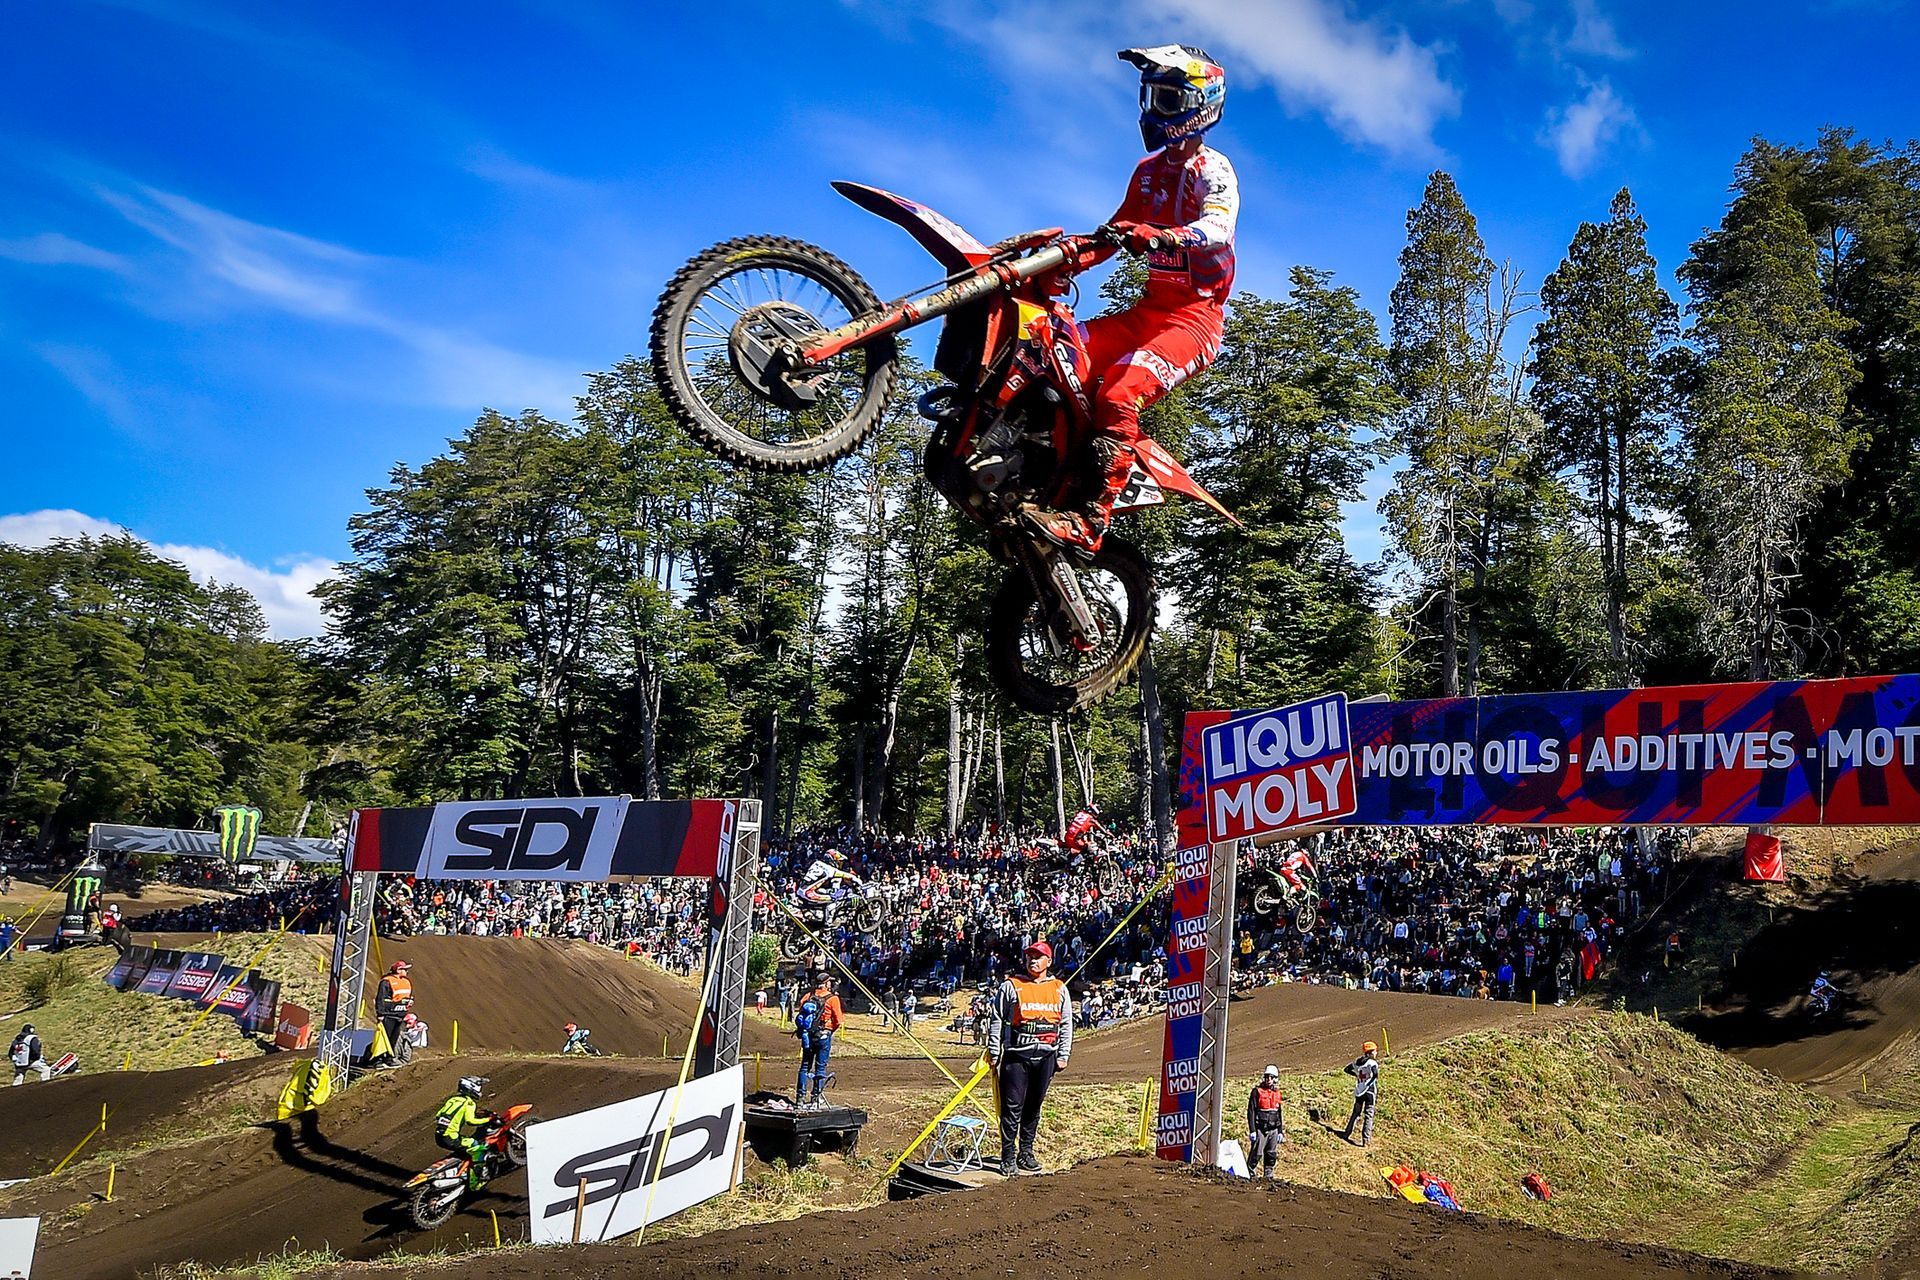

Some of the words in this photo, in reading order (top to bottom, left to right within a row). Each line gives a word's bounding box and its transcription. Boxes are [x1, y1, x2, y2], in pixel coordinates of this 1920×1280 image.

[1210, 700, 1342, 780] LIQUI
[1362, 742, 1474, 778] MOTOR
[1483, 738, 1560, 773] OILS
[1586, 731, 1796, 772] ADDITIVES
[1828, 726, 1920, 768] MOT
[1213, 757, 1348, 836] MOLY
[1175, 847, 1207, 866] LIQUI
[1175, 861, 1208, 881] MOLY
[1178, 917, 1208, 936] LIQU
[1169, 1000, 1200, 1019] MOLY
[1170, 1076, 1197, 1093] MOL
[1156, 1129, 1189, 1147] MOLY
